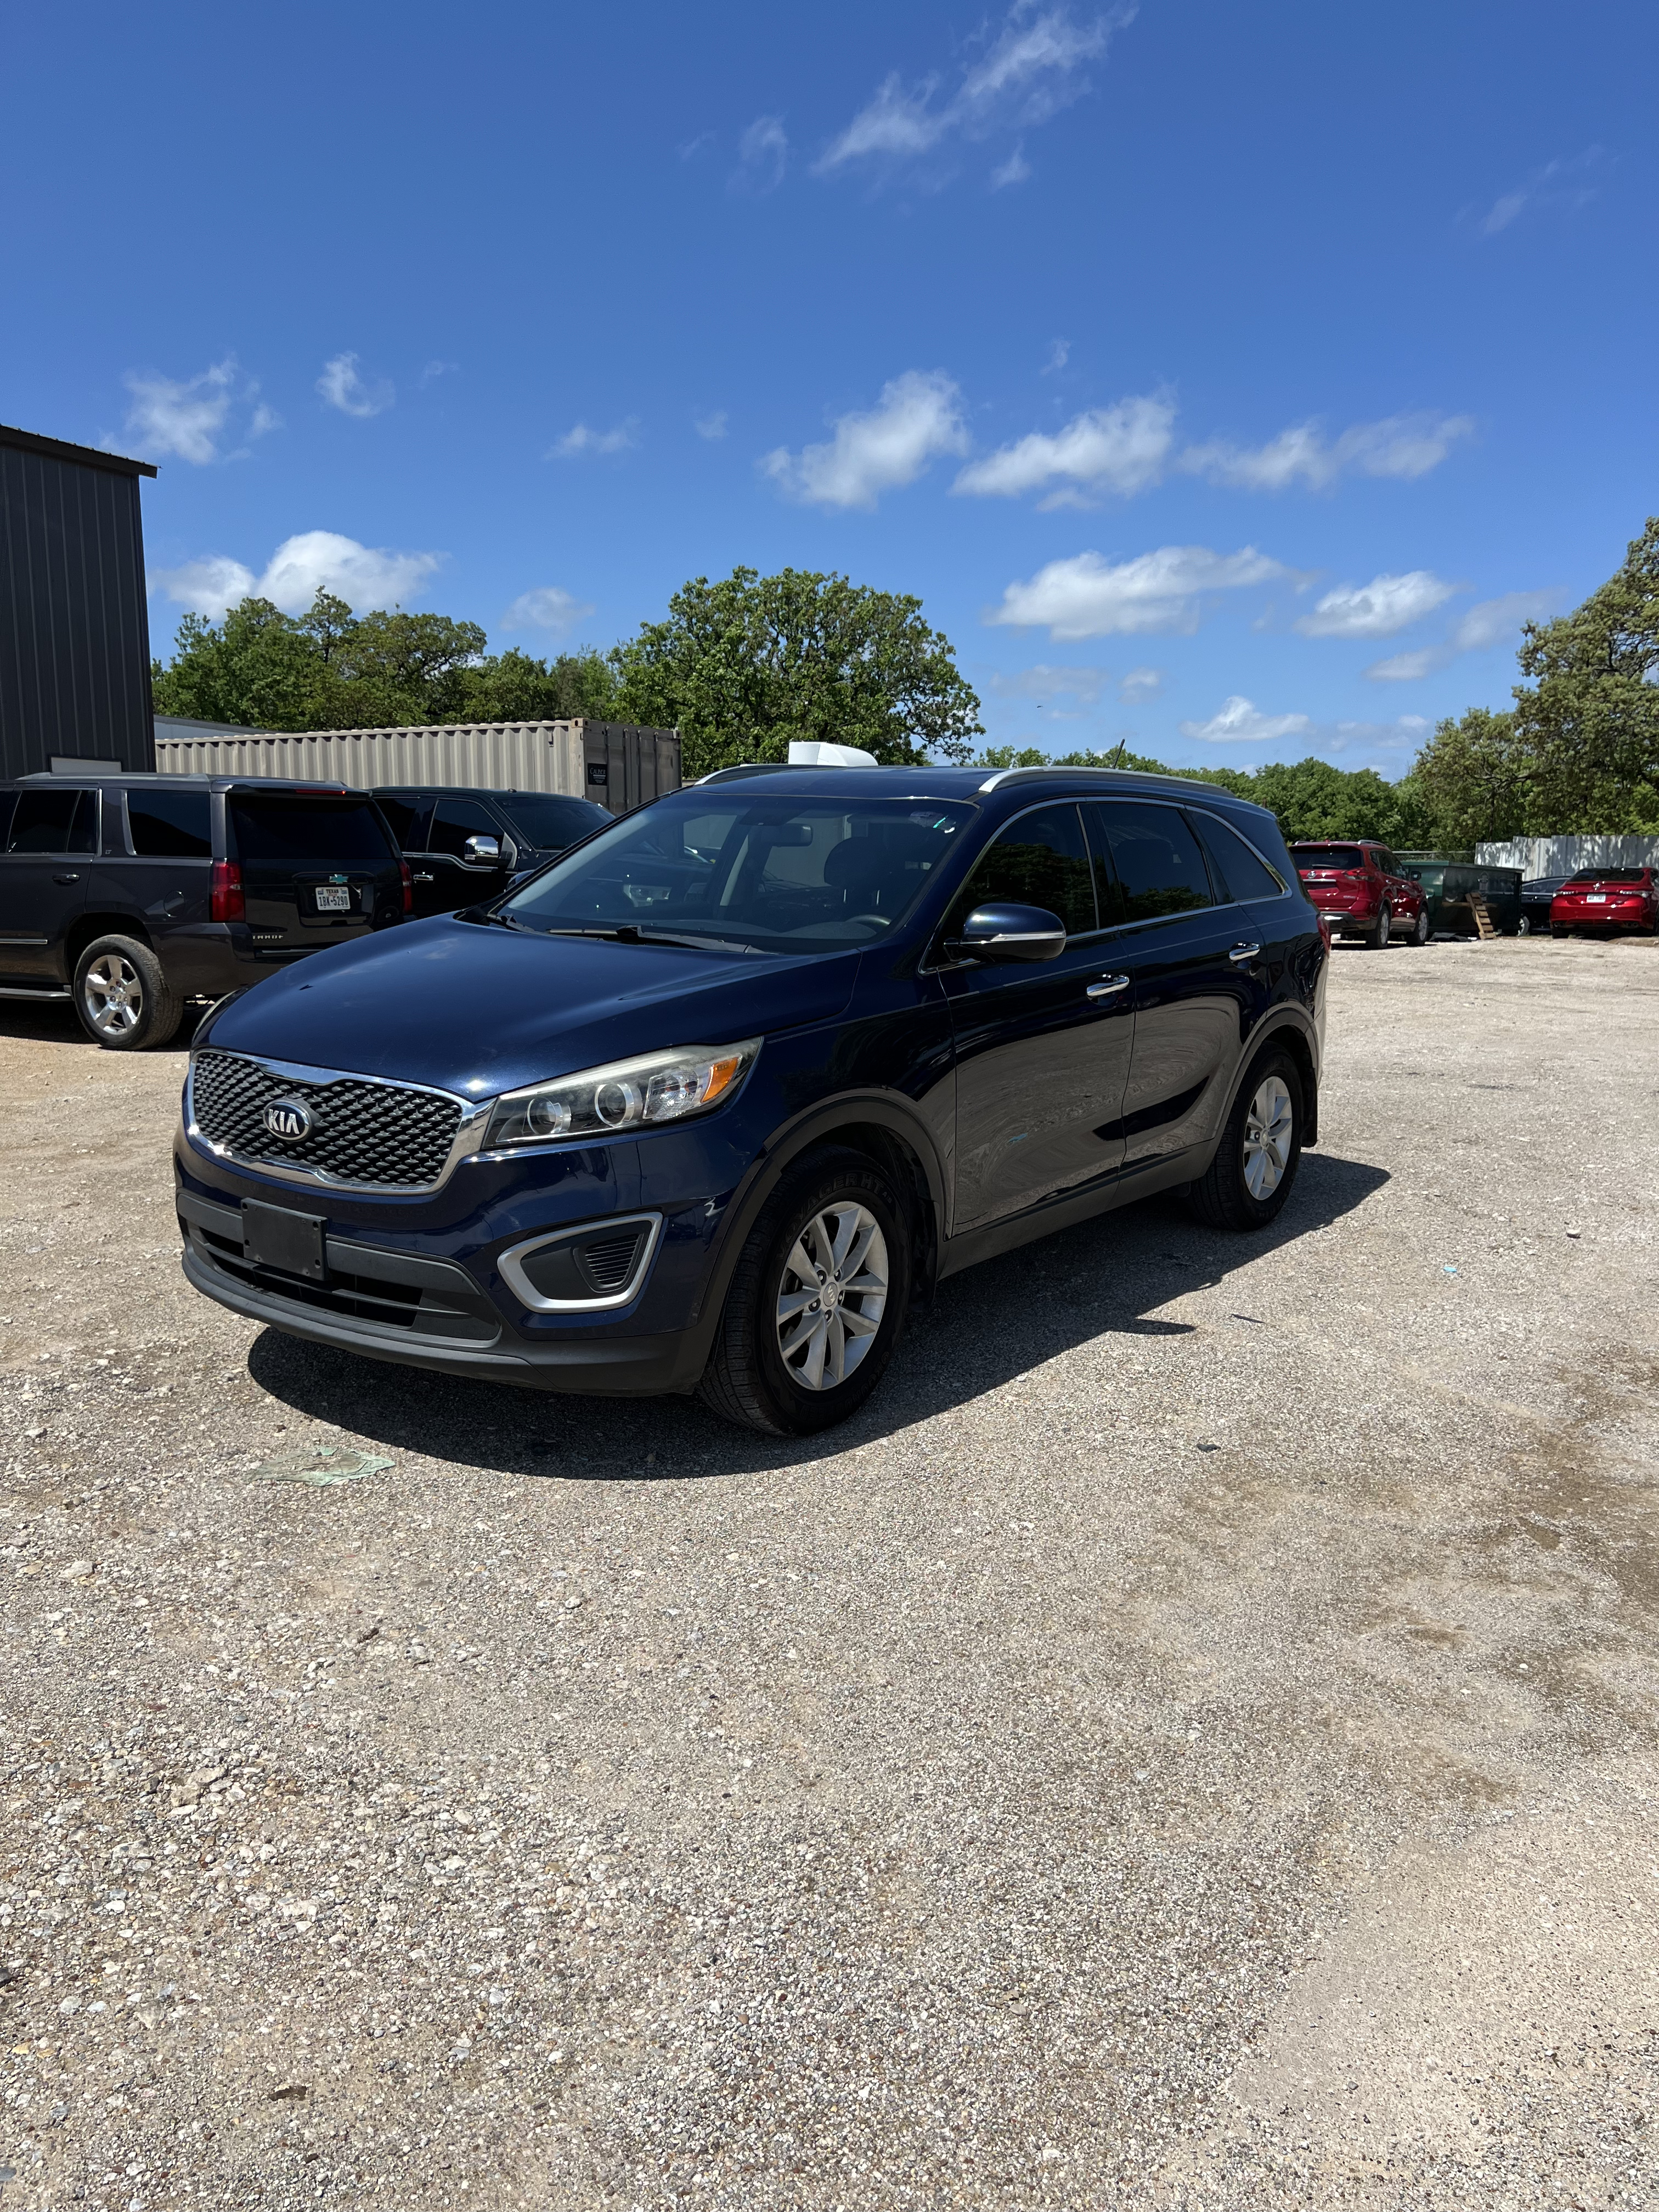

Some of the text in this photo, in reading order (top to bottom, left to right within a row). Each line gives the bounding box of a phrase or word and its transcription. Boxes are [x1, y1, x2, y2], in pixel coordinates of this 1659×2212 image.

[269, 1109, 300, 1134] KIA
[776, 1173, 857, 1260] VOYAGER
[860, 1173, 884, 1195] HT
[827, 1285, 836, 1304] KIA
